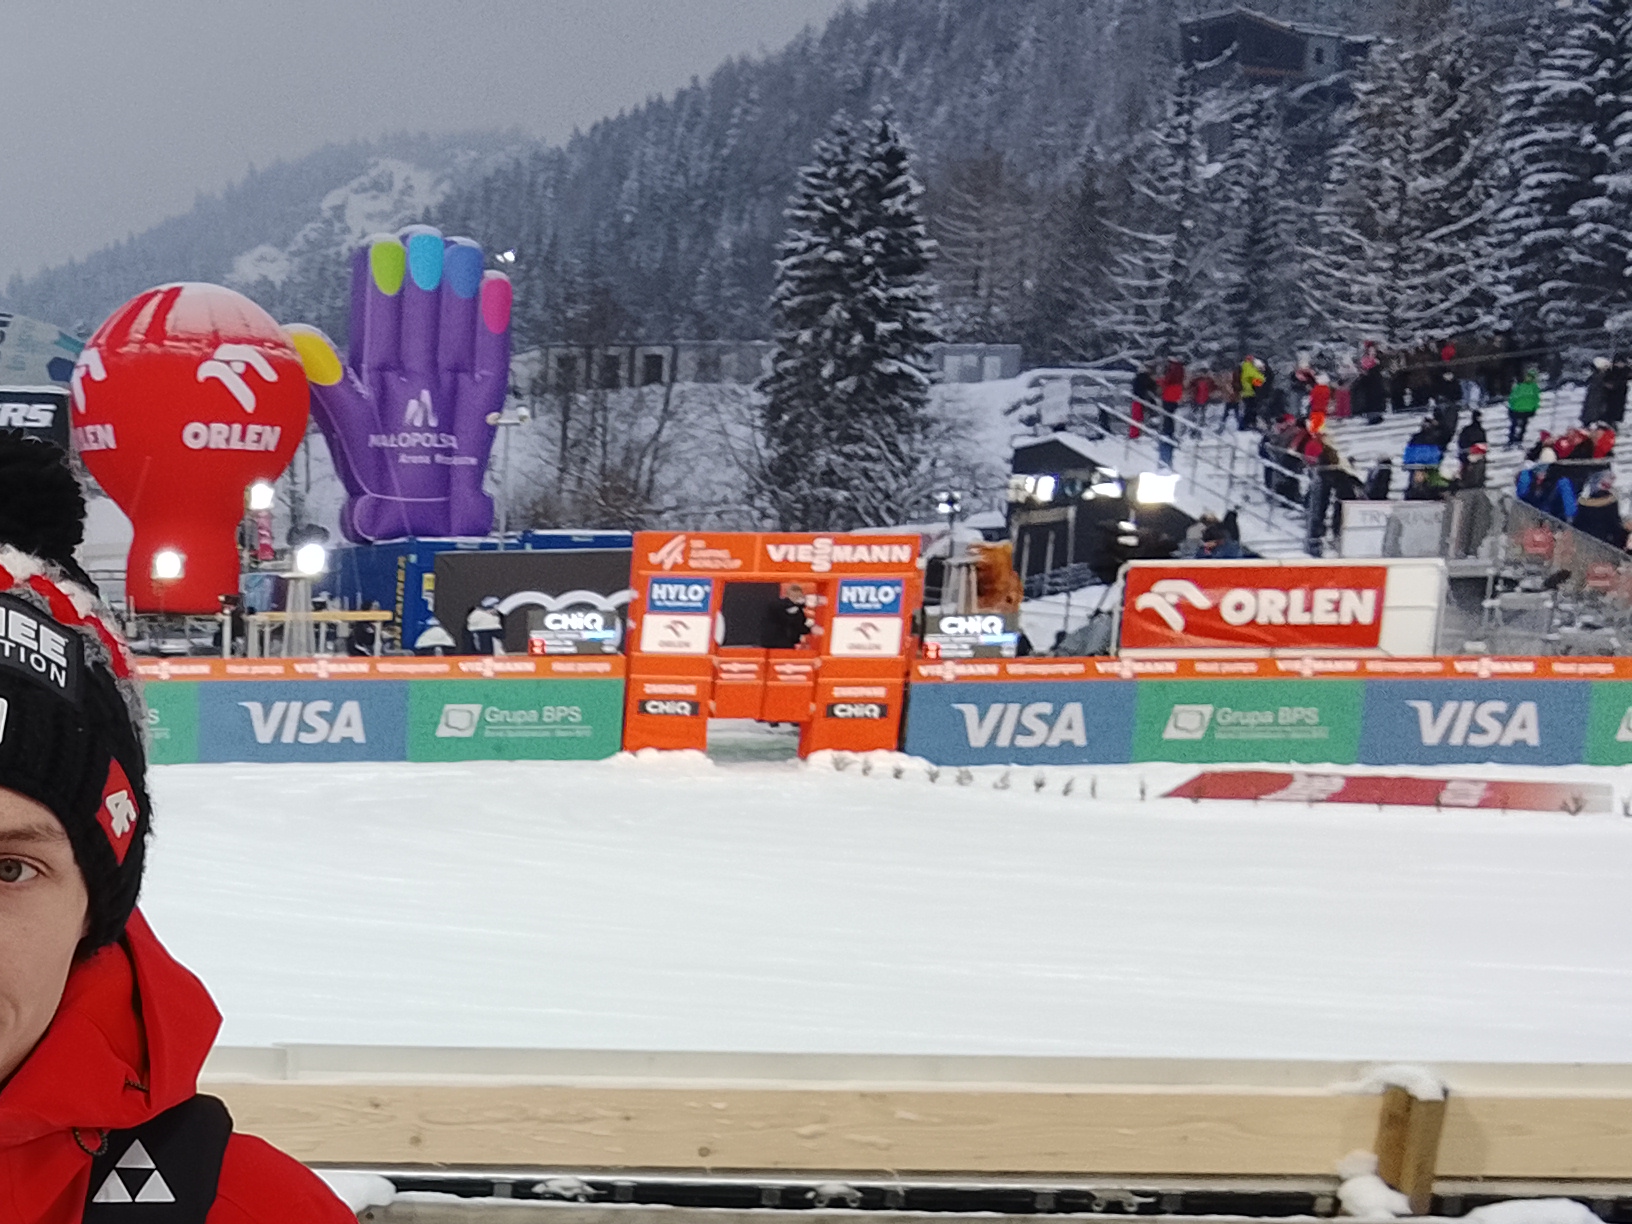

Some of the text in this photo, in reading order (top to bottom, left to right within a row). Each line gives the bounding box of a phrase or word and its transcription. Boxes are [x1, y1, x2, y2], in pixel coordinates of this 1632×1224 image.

[182, 421, 282, 452] ORLEN
[1219, 586, 1377, 627] ORLEN
[237, 700, 367, 744] VISA
[951, 701, 1088, 749] VISA
[1405, 700, 1541, 747] VISA
